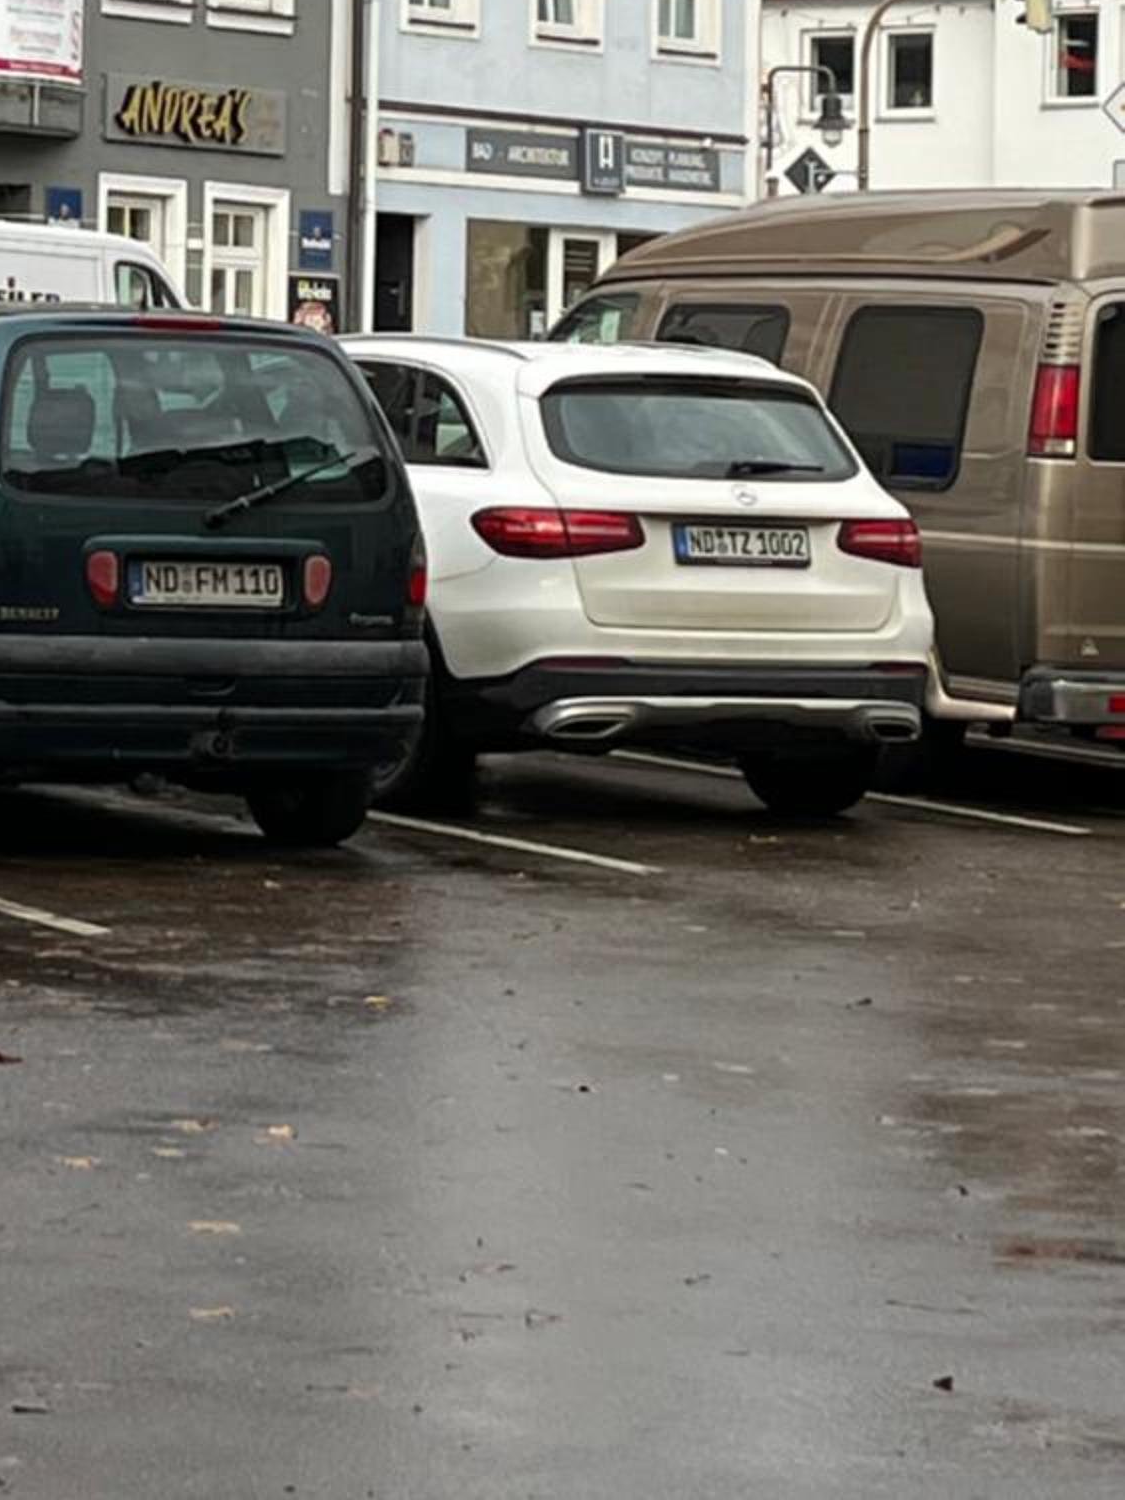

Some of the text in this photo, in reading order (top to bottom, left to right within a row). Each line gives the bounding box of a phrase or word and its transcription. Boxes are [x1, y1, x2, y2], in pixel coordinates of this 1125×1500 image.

[117, 84, 252, 145] ANDREA'S
[689, 529, 806, 557] ND TZ 1002
[145, 565, 281, 596] ND FM 110
